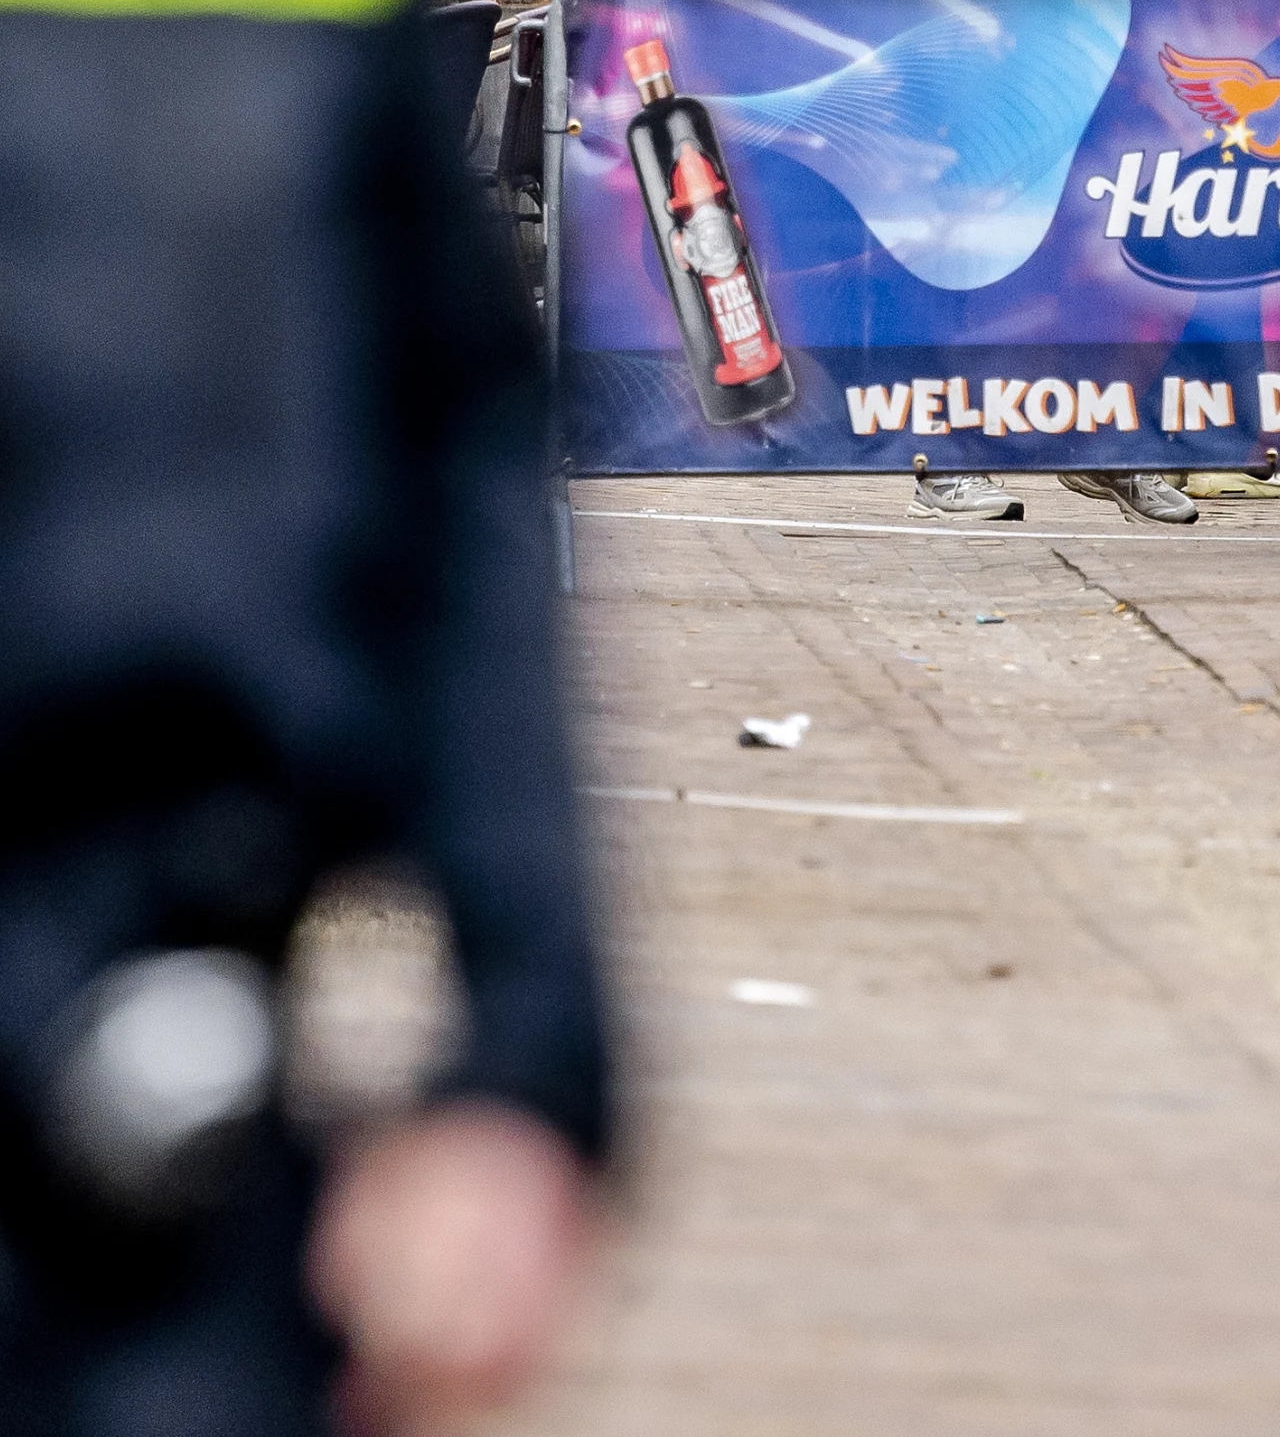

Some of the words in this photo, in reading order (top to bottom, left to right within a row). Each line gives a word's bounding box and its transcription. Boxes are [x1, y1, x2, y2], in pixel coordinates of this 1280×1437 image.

[717, 302, 762, 344] MAN
[845, 376, 1139, 437] WELKOM
[1161, 375, 1236, 432] IN
